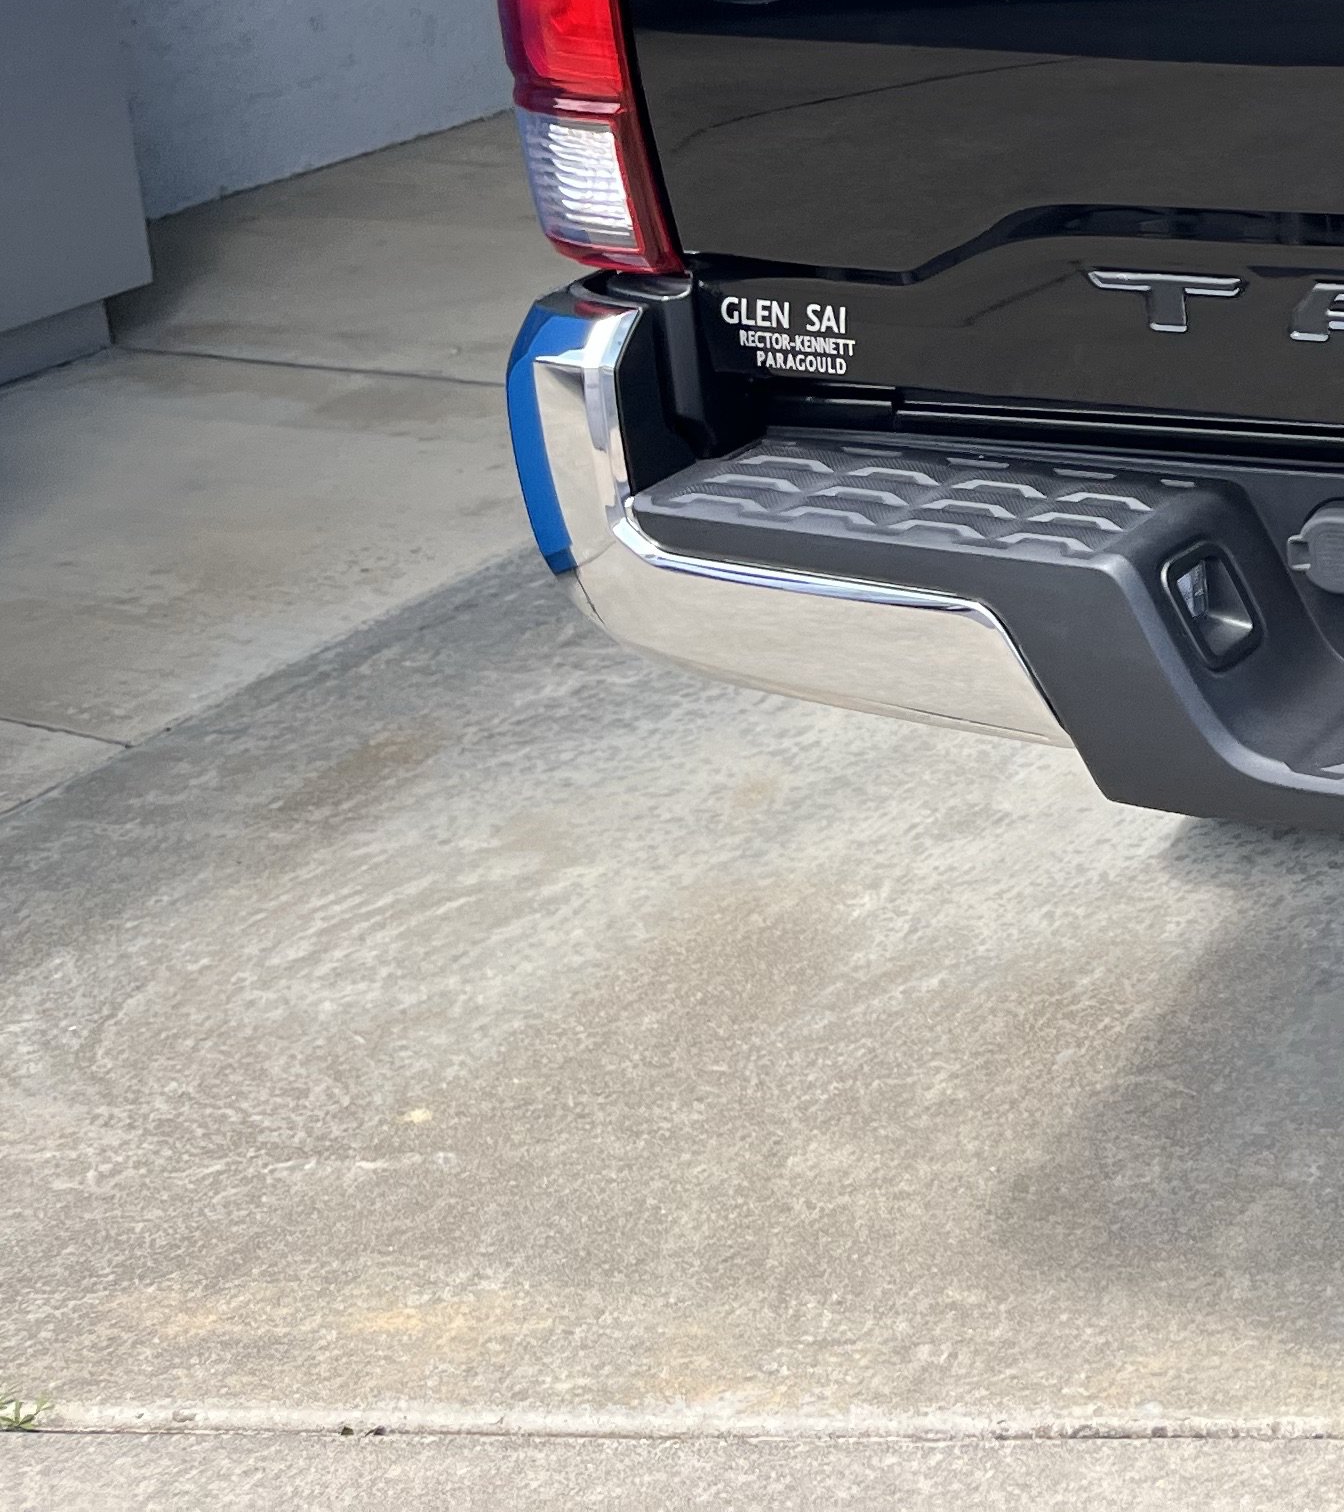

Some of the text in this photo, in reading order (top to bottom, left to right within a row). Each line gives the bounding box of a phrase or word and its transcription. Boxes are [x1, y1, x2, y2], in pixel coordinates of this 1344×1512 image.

[721, 296, 847, 334] GLEN SAI
[739, 330, 856, 356] RECTOR-KENNETT
[756, 351, 848, 375] PARAGOULD
